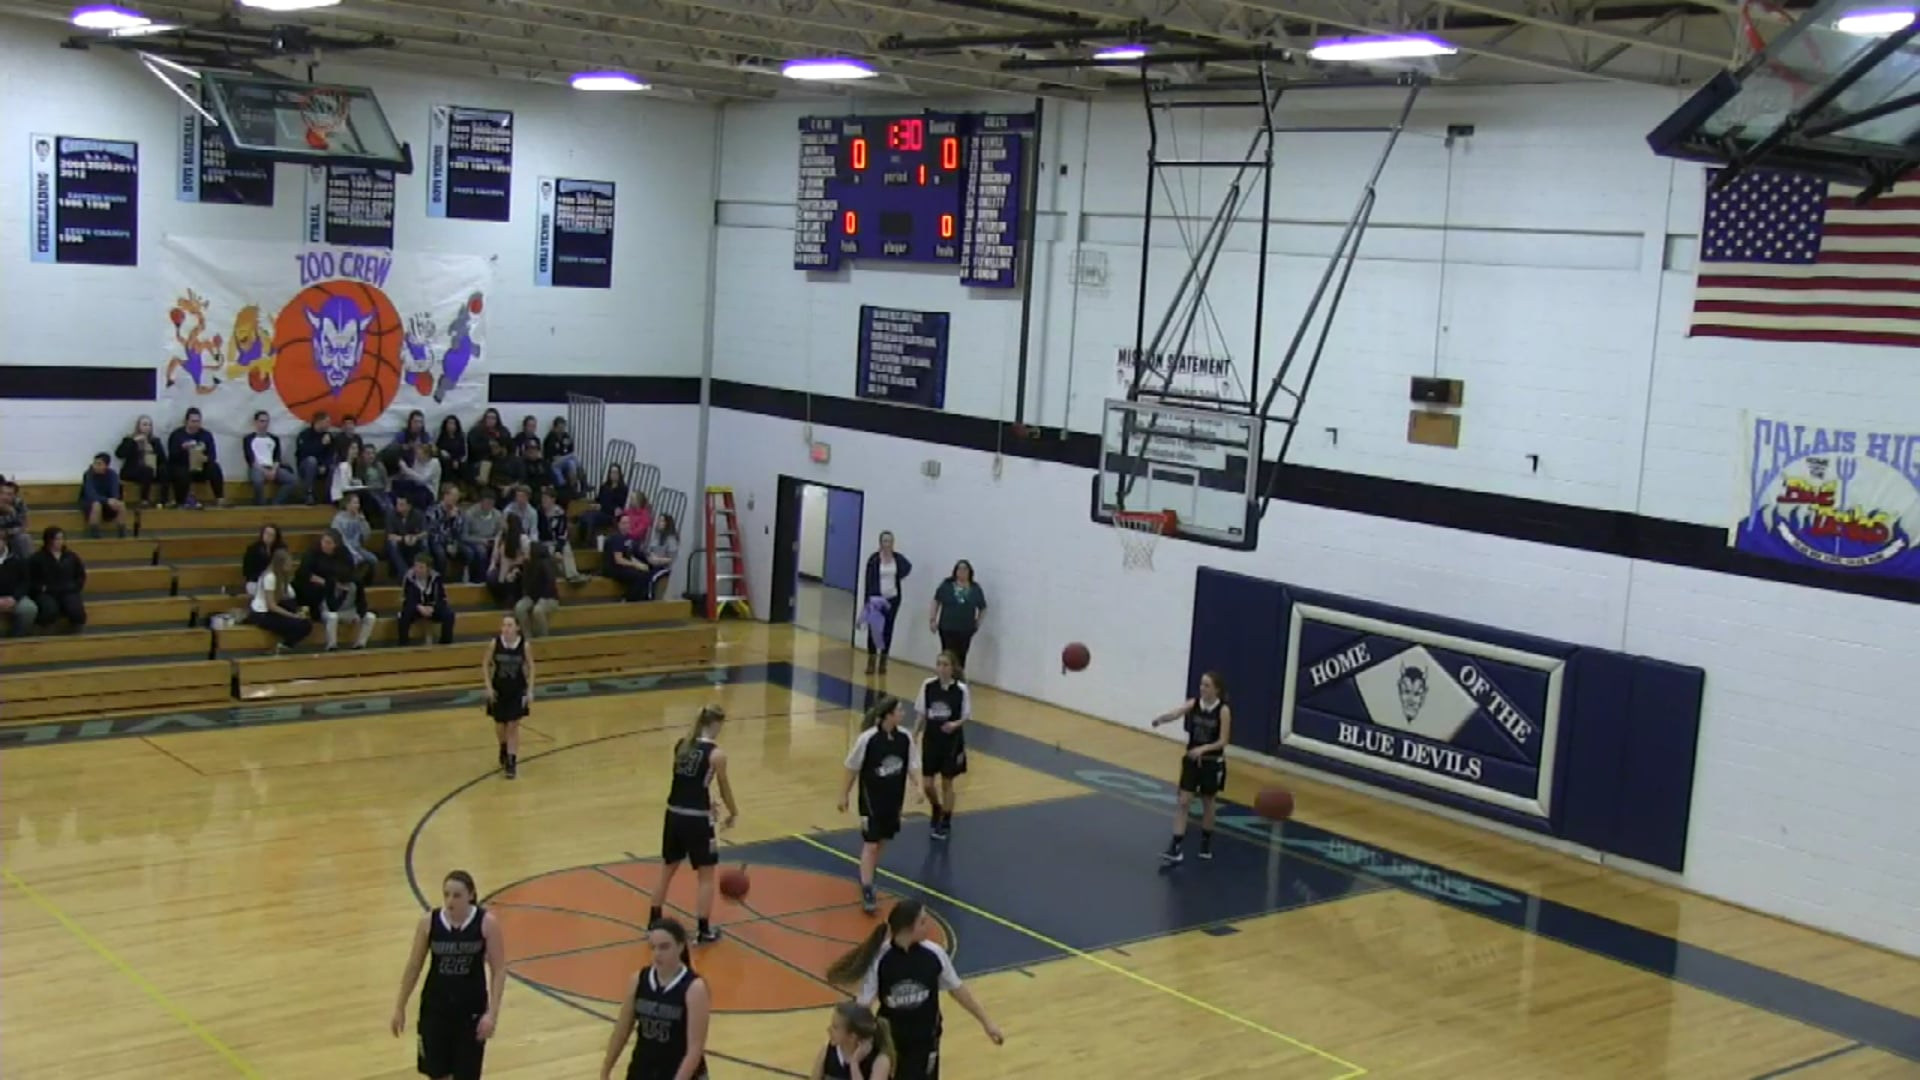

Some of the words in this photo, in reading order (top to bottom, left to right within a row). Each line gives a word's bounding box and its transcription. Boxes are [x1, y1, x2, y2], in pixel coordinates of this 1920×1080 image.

[852, 138, 866, 169] 0
[943, 138, 957, 169] 0
[918, 165, 926, 185] 1
[845, 211, 857, 235] 0
[941, 215, 953, 237] 0
[296, 252, 335, 287] ZOO
[340, 251, 393, 287] CREW
[1748, 418, 1857, 532] CALAIS
[1309, 642, 1371, 687] HOME
[1459, 665, 1489, 699] OF
[1489, 688, 1532, 743] THE
[1338, 722, 1395, 756] BLUE
[1402, 739, 1483, 780] DEVILS
